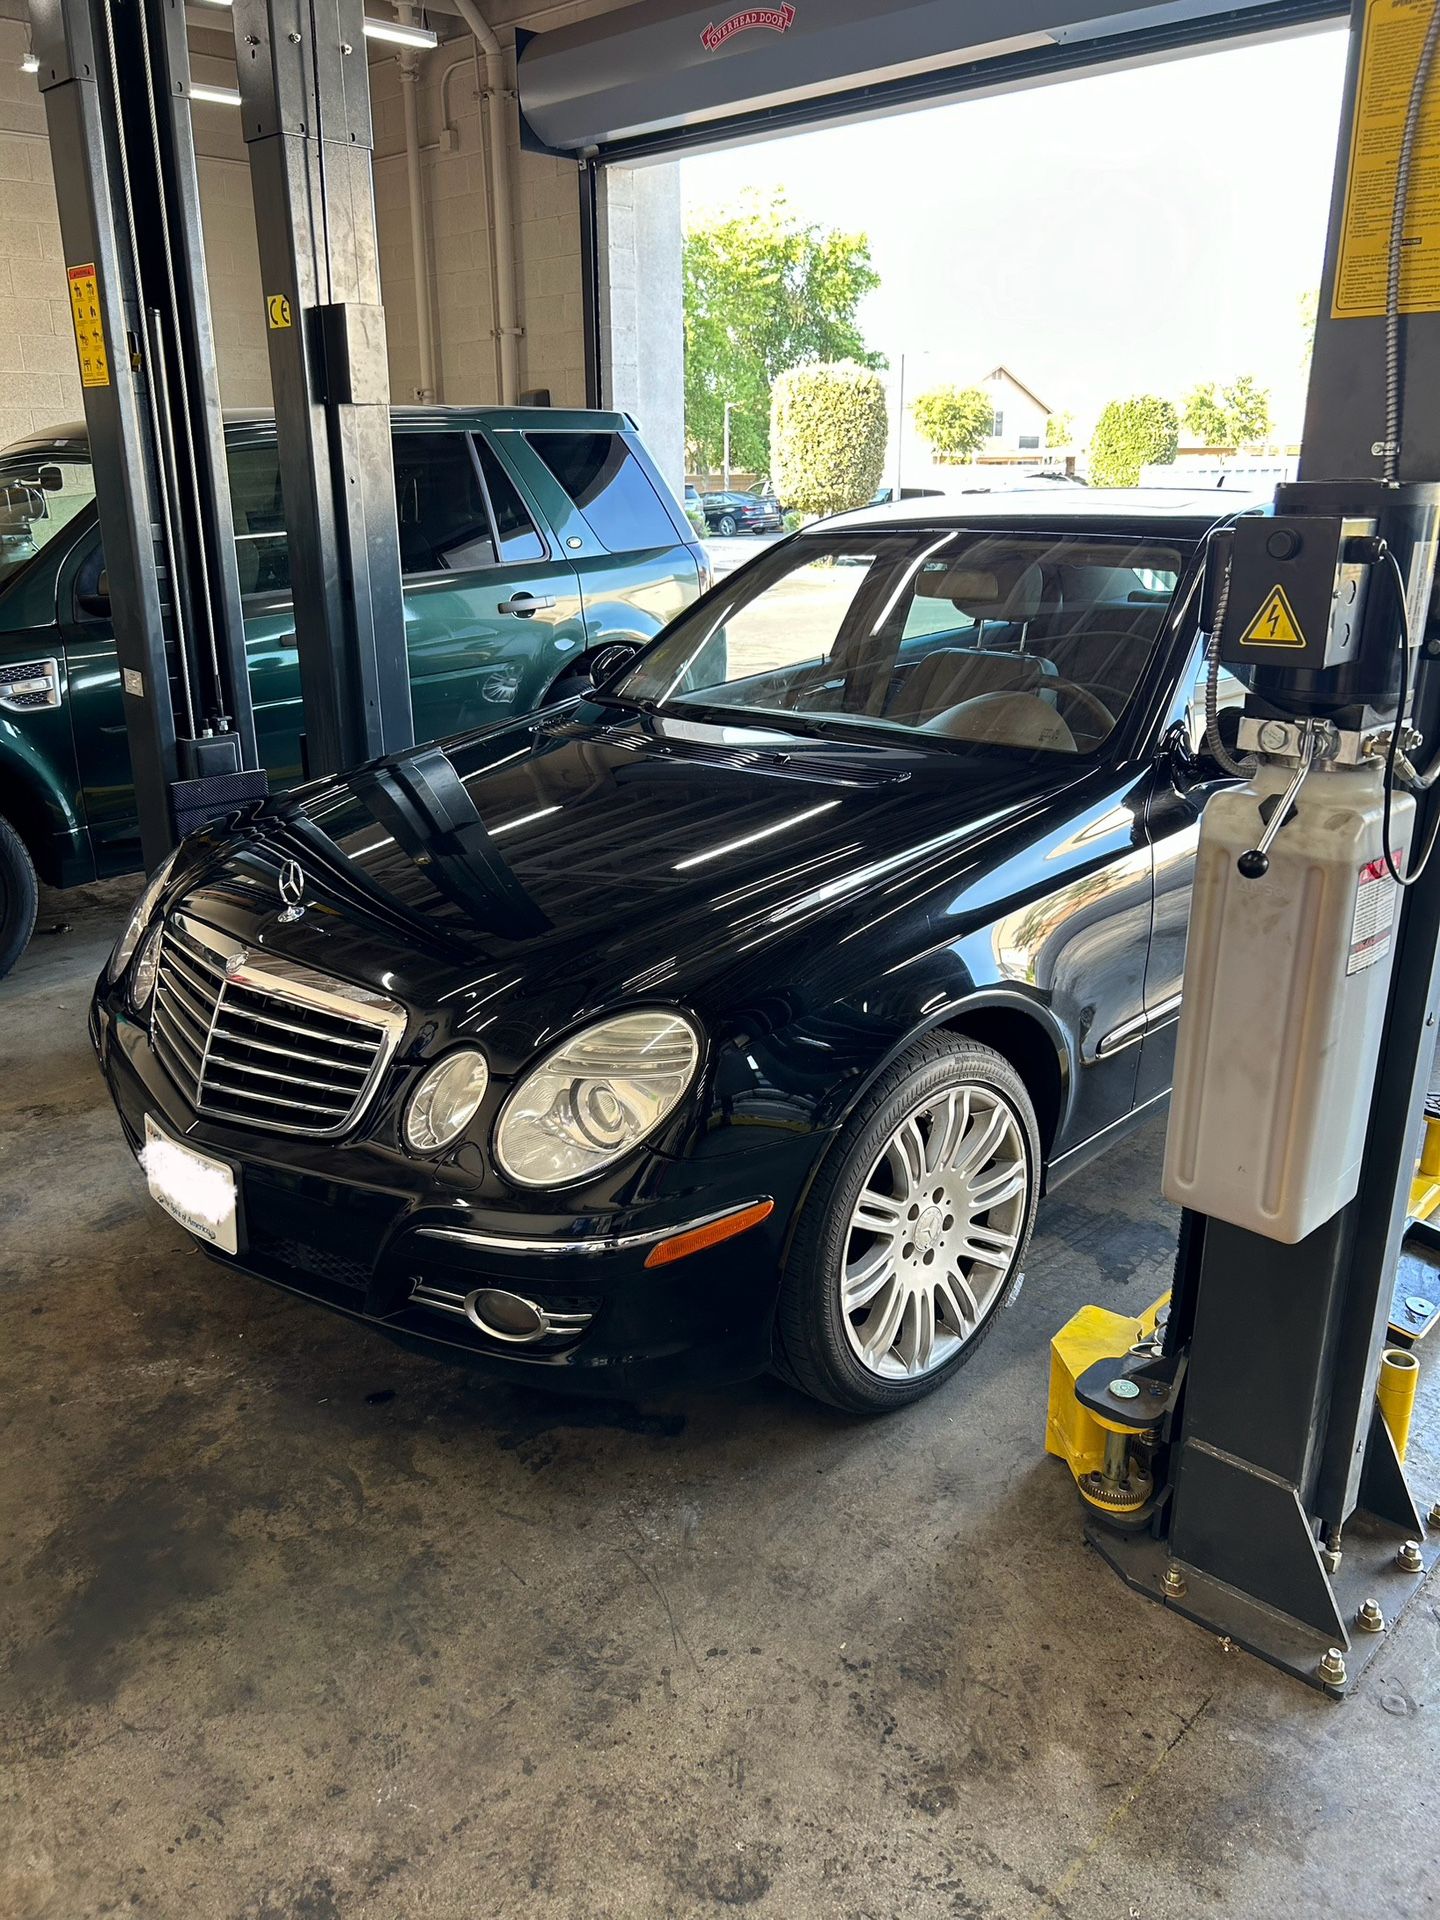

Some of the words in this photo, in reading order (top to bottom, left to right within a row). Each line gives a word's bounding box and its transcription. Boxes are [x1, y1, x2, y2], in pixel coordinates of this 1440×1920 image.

[711, 13, 757, 44] OVERHEAD
[760, 12, 785, 28] DOOR
[270, 298, 290, 325] CE
